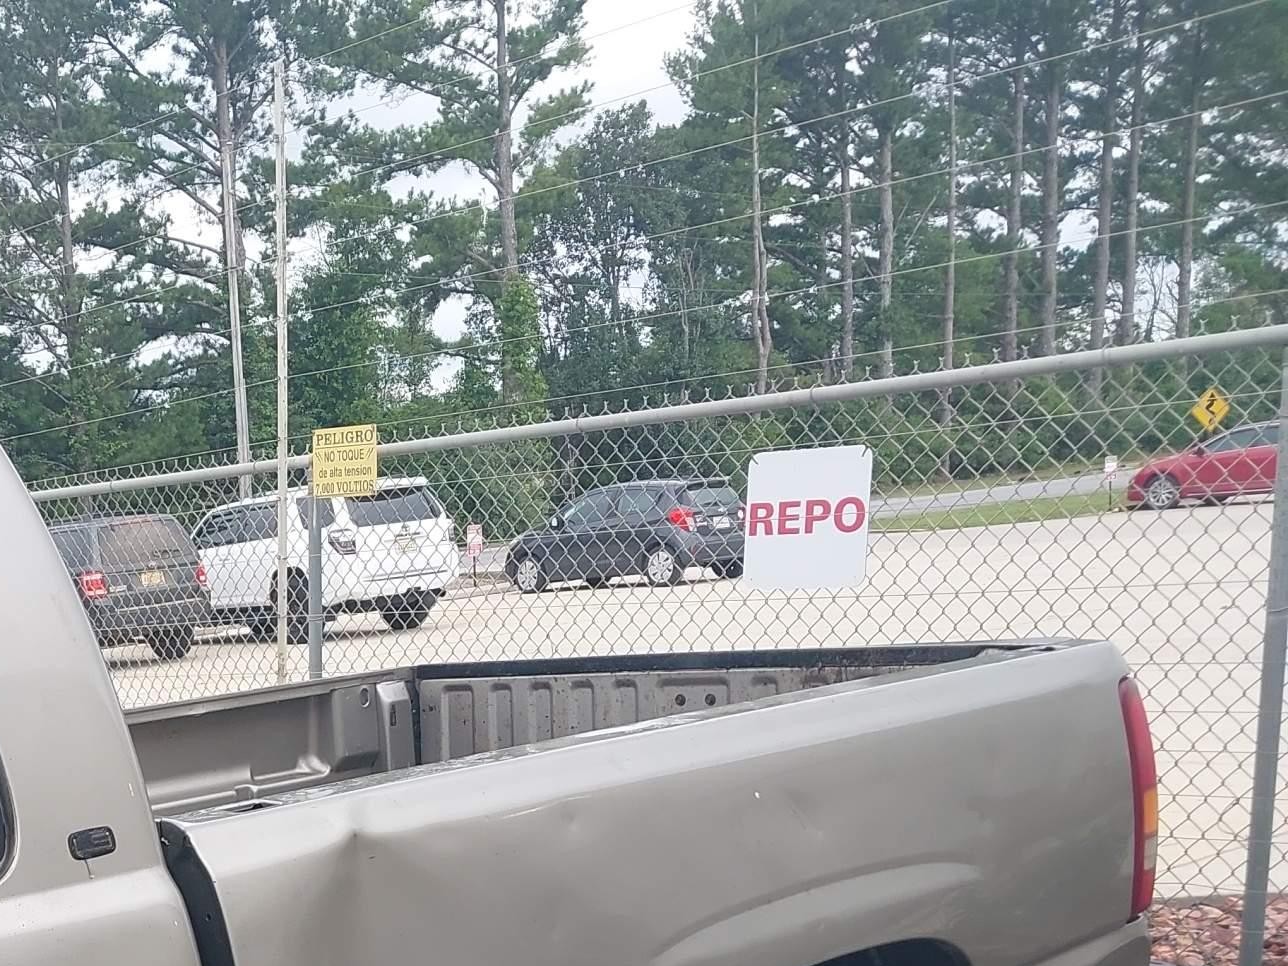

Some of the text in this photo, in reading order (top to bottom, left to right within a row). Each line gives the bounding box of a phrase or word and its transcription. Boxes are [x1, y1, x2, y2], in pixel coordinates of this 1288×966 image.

[316, 429, 373, 446] PELIGRO
[324, 448, 365, 462] NO TOQUE
[319, 467, 328, 479] de
[329, 466, 343, 478] alta
[337, 480, 374, 492] VOLTIOS
[748, 496, 866, 536] REPO
